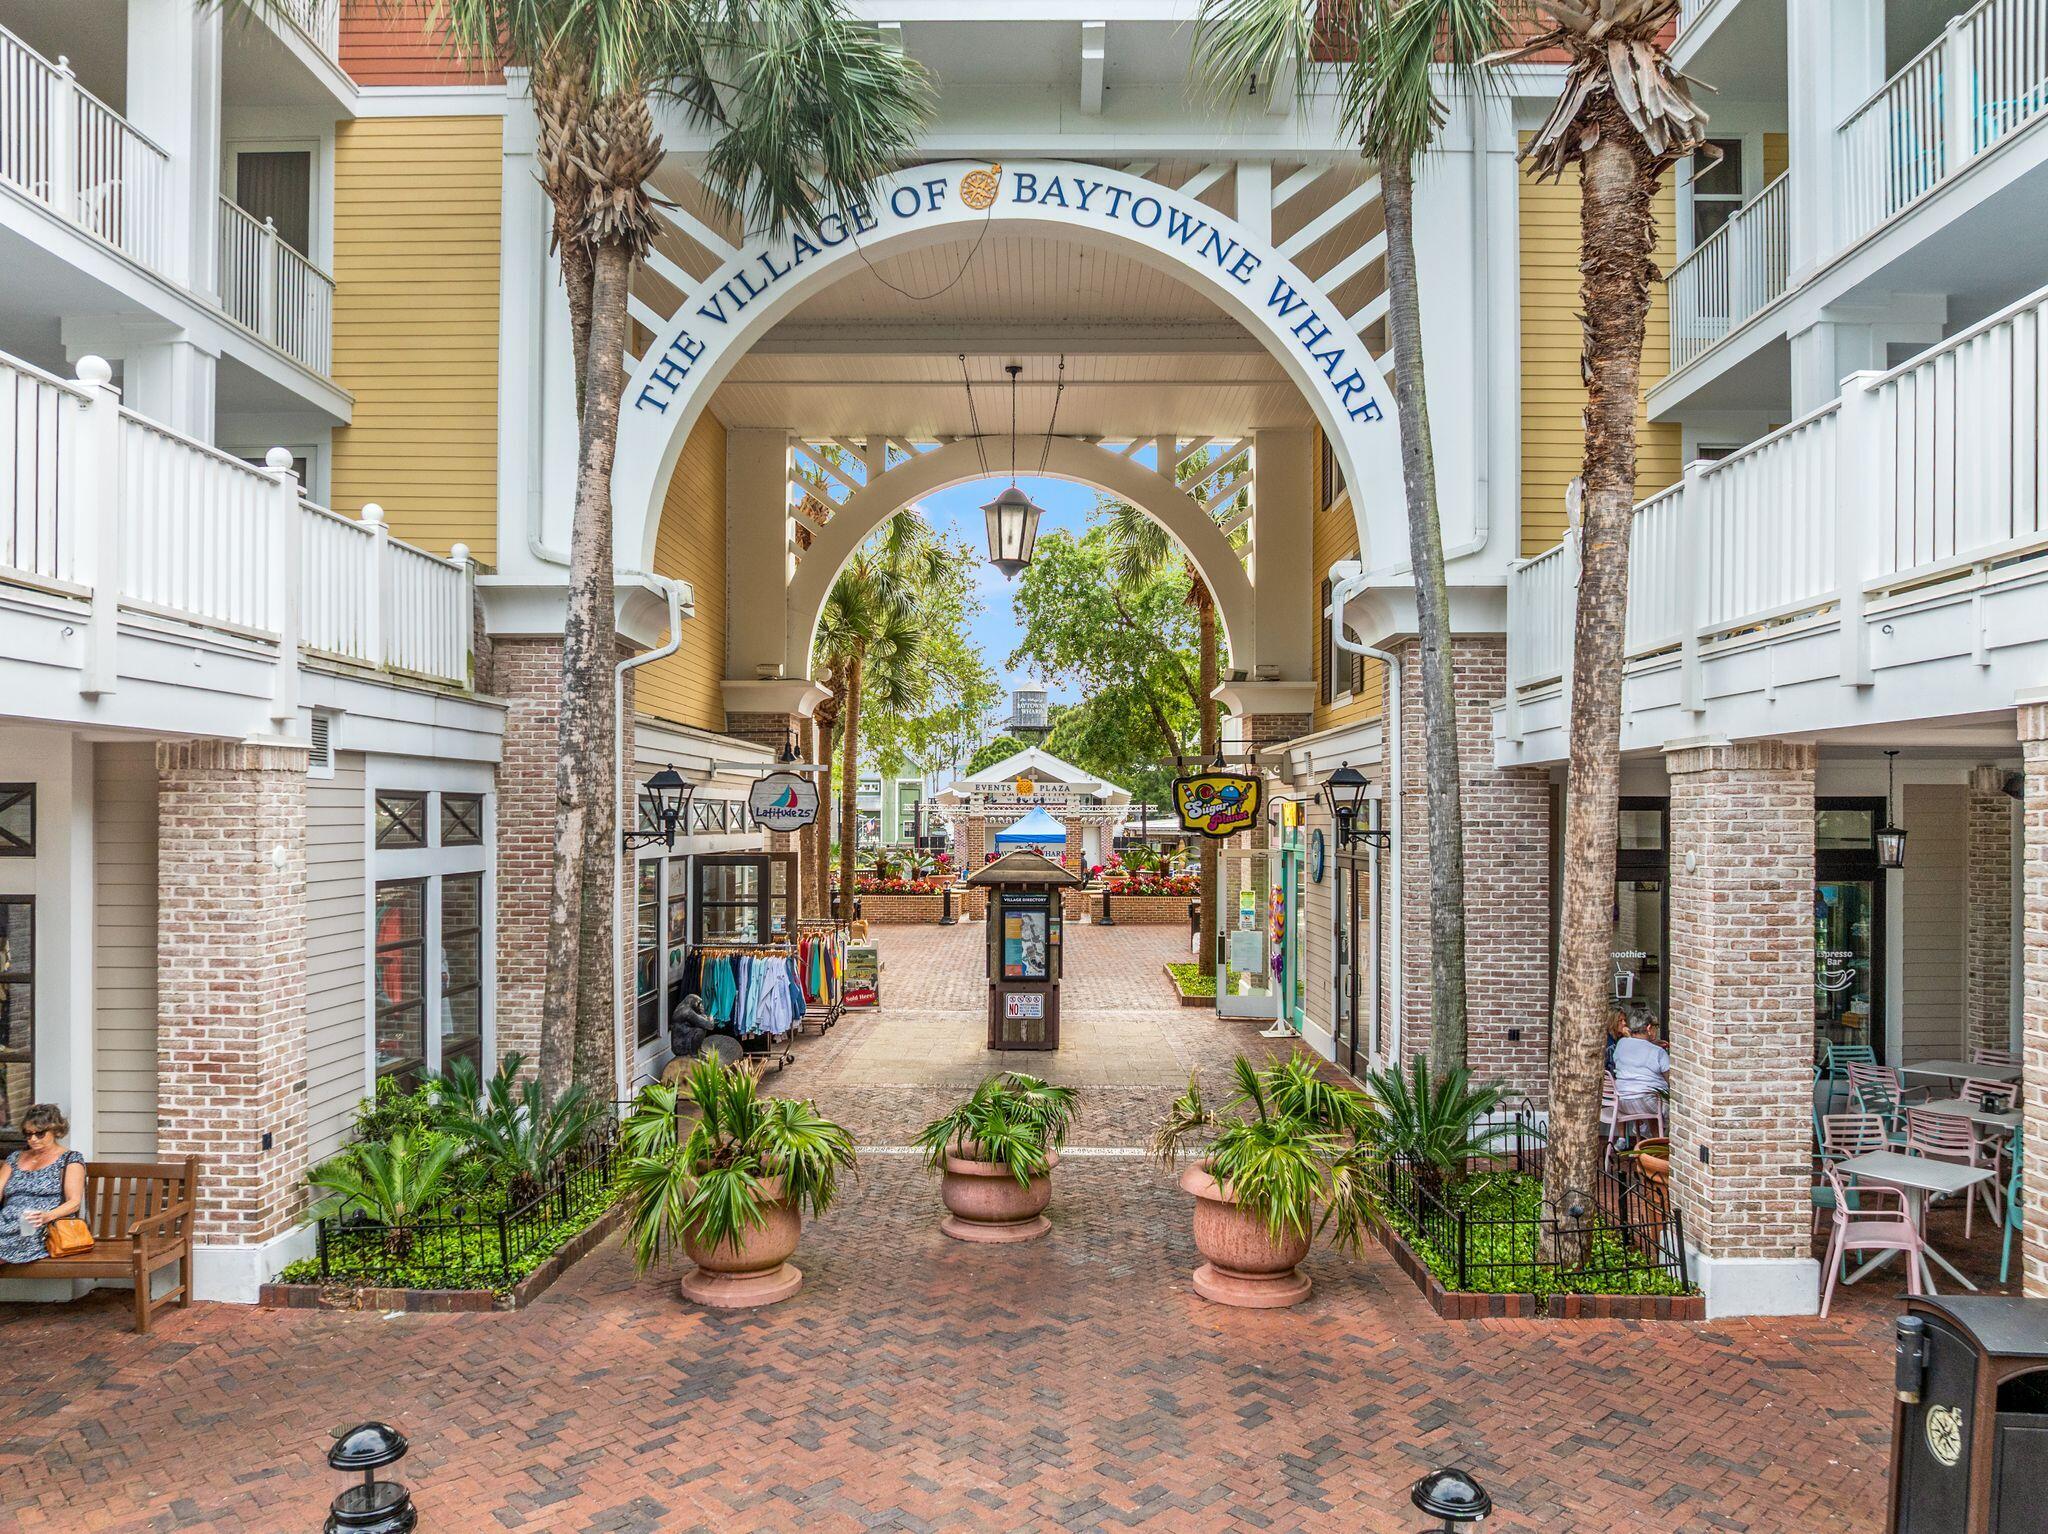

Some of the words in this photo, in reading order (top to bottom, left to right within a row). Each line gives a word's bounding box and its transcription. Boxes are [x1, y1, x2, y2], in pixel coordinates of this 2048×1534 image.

[635, 330, 706, 415] THE
[696, 201, 879, 325] VILLAGE
[890, 178, 948, 218] OF
[1012, 172, 1262, 285] BAYTOWNE
[1267, 274, 1384, 424] WHARF
[975, 783, 1012, 792] EVENTS
[1039, 784, 1071, 793] PLAZA
[756, 807, 797, 819] Latitude
[1207, 810, 1249, 831] Planet
[1816, 950, 1853, 960] Espresso
[1827, 958, 1843, 966] Bar
[845, 994, 859, 1003] Sold
[1009, 1003, 1019, 1016] NO
